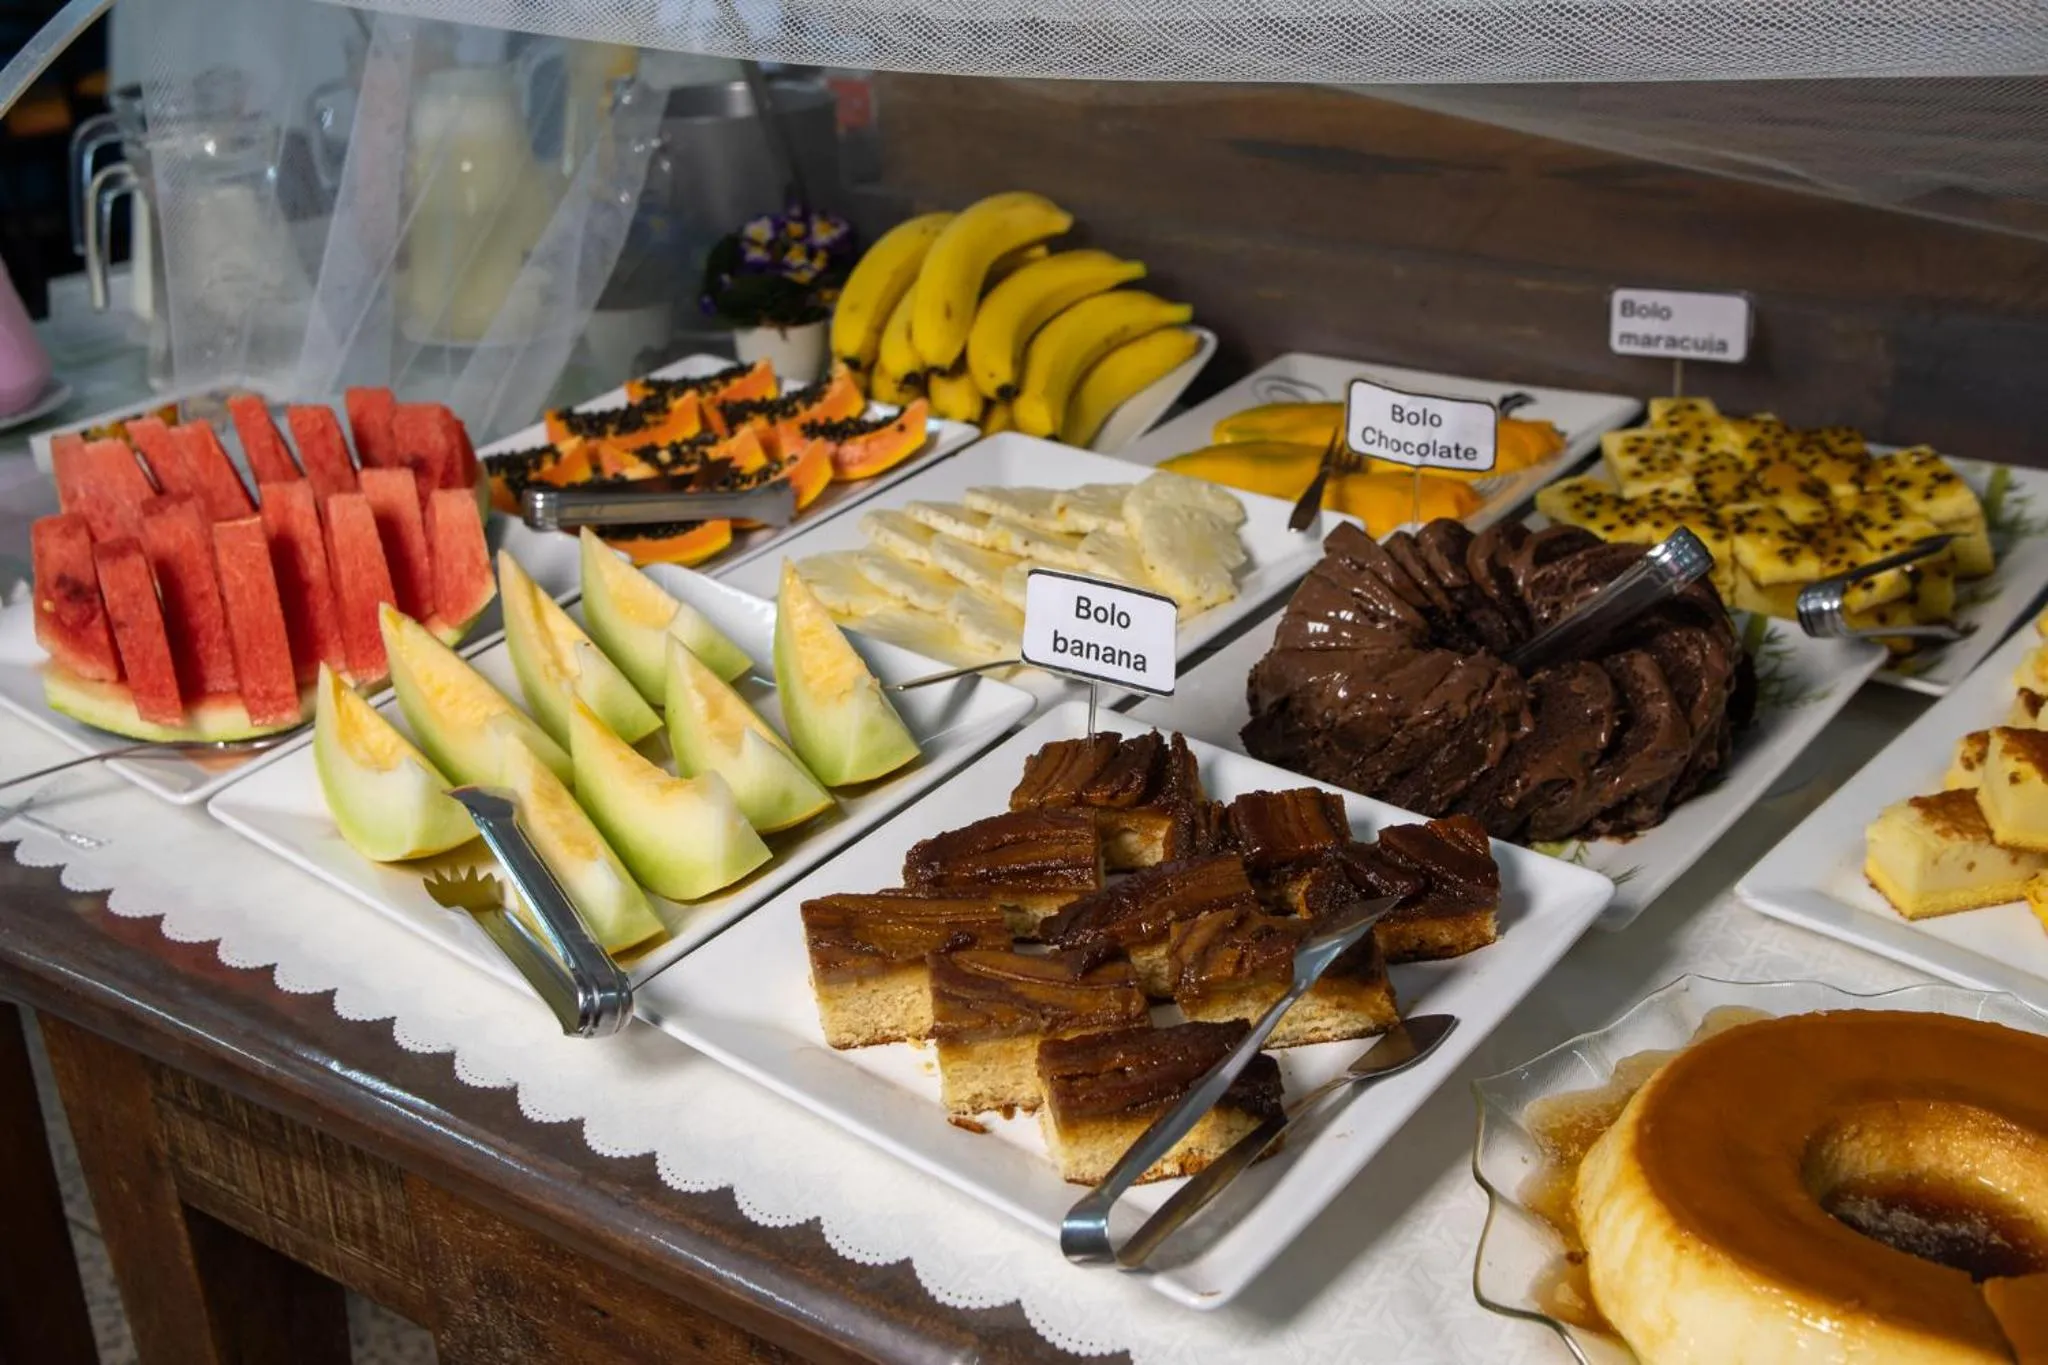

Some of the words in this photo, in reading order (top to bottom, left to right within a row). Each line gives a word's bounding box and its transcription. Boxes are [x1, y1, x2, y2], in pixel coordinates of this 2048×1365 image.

[1620, 299, 1673, 321] Bolo
[1391, 404, 1442, 428] Bolo
[1361, 426, 1478, 461] Chocolate
[1075, 596, 1131, 629] Bolo
[1052, 630, 1147, 673] banana
